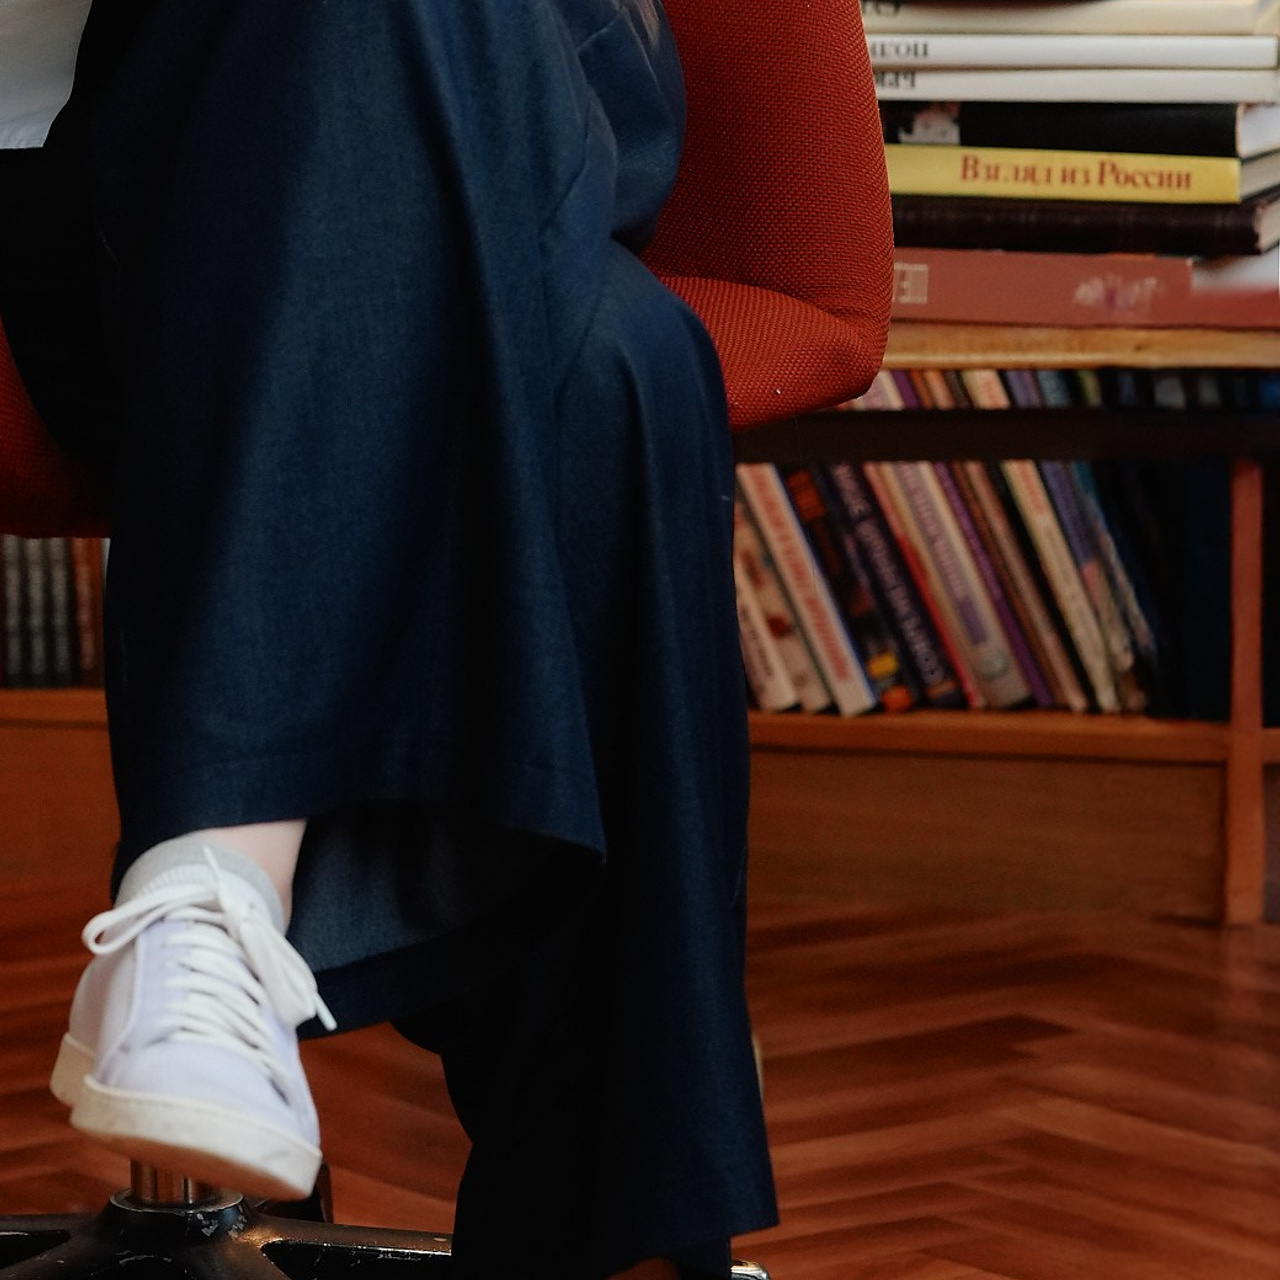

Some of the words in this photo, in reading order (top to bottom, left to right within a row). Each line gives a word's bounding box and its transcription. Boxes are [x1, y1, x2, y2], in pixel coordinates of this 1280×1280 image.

[961, 155, 1054, 187] Взгляд
[1060, 166, 1092, 187] из
[1097, 159, 1193, 190] России
